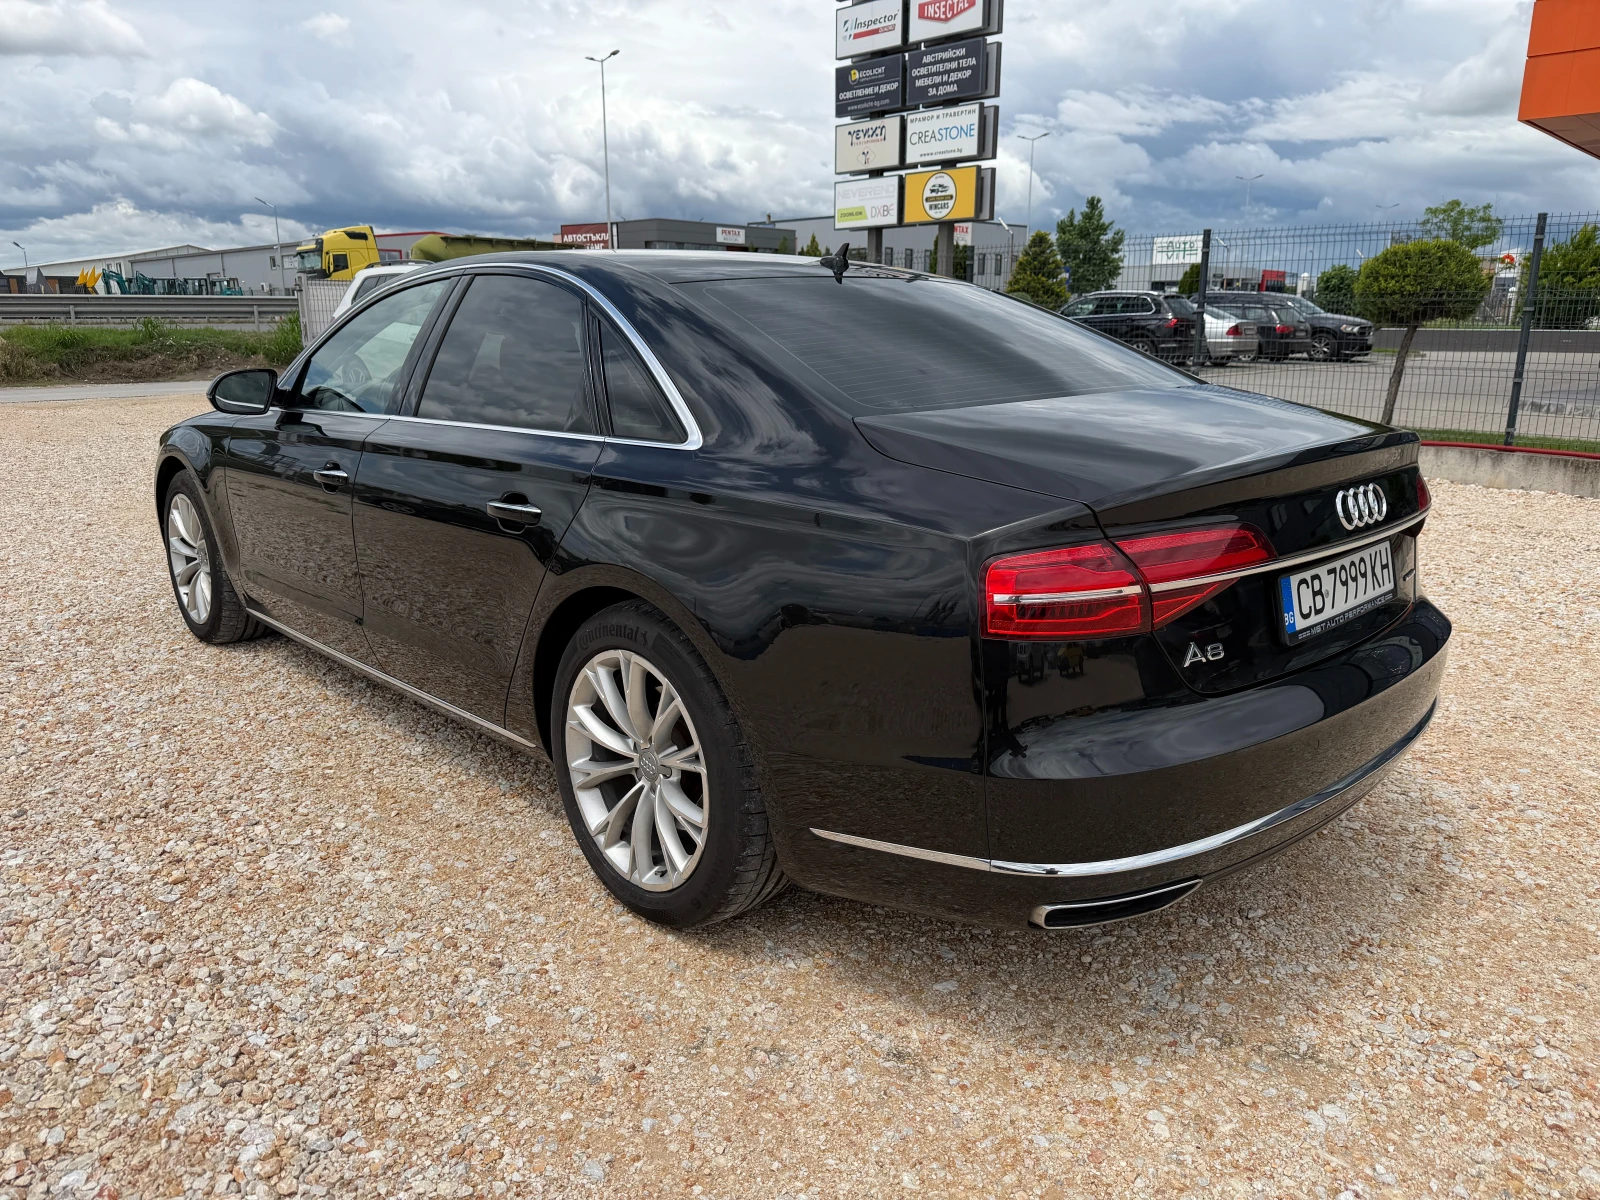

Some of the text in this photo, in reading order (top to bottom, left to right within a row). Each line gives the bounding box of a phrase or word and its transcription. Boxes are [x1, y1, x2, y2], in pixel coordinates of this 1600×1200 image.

[853, 13, 898, 30] Inspector
[922, 47, 966, 64] АВСТРИЙСКИ
[911, 56, 977, 77] ОСВЕТИТЕЛНИ ТЕЛА
[915, 69, 972, 87] МЕБЕЛИ И ДЕКОР
[838, 81, 899, 101] ОСВЕТЛЕНИЕ И ДЕКОР
[927, 83, 958, 96] ЗА ДОМА
[909, 114, 935, 124] МРАМОР
[942, 107, 977, 119] ТРАВЕРТИН
[909, 123, 976, 146] CREASTONE
[953, 225, 969, 235] NTAX
[1284, 611, 1295, 626] BG
[579, 622, 640, 652] Continental
[1182, 641, 1225, 668] A8
